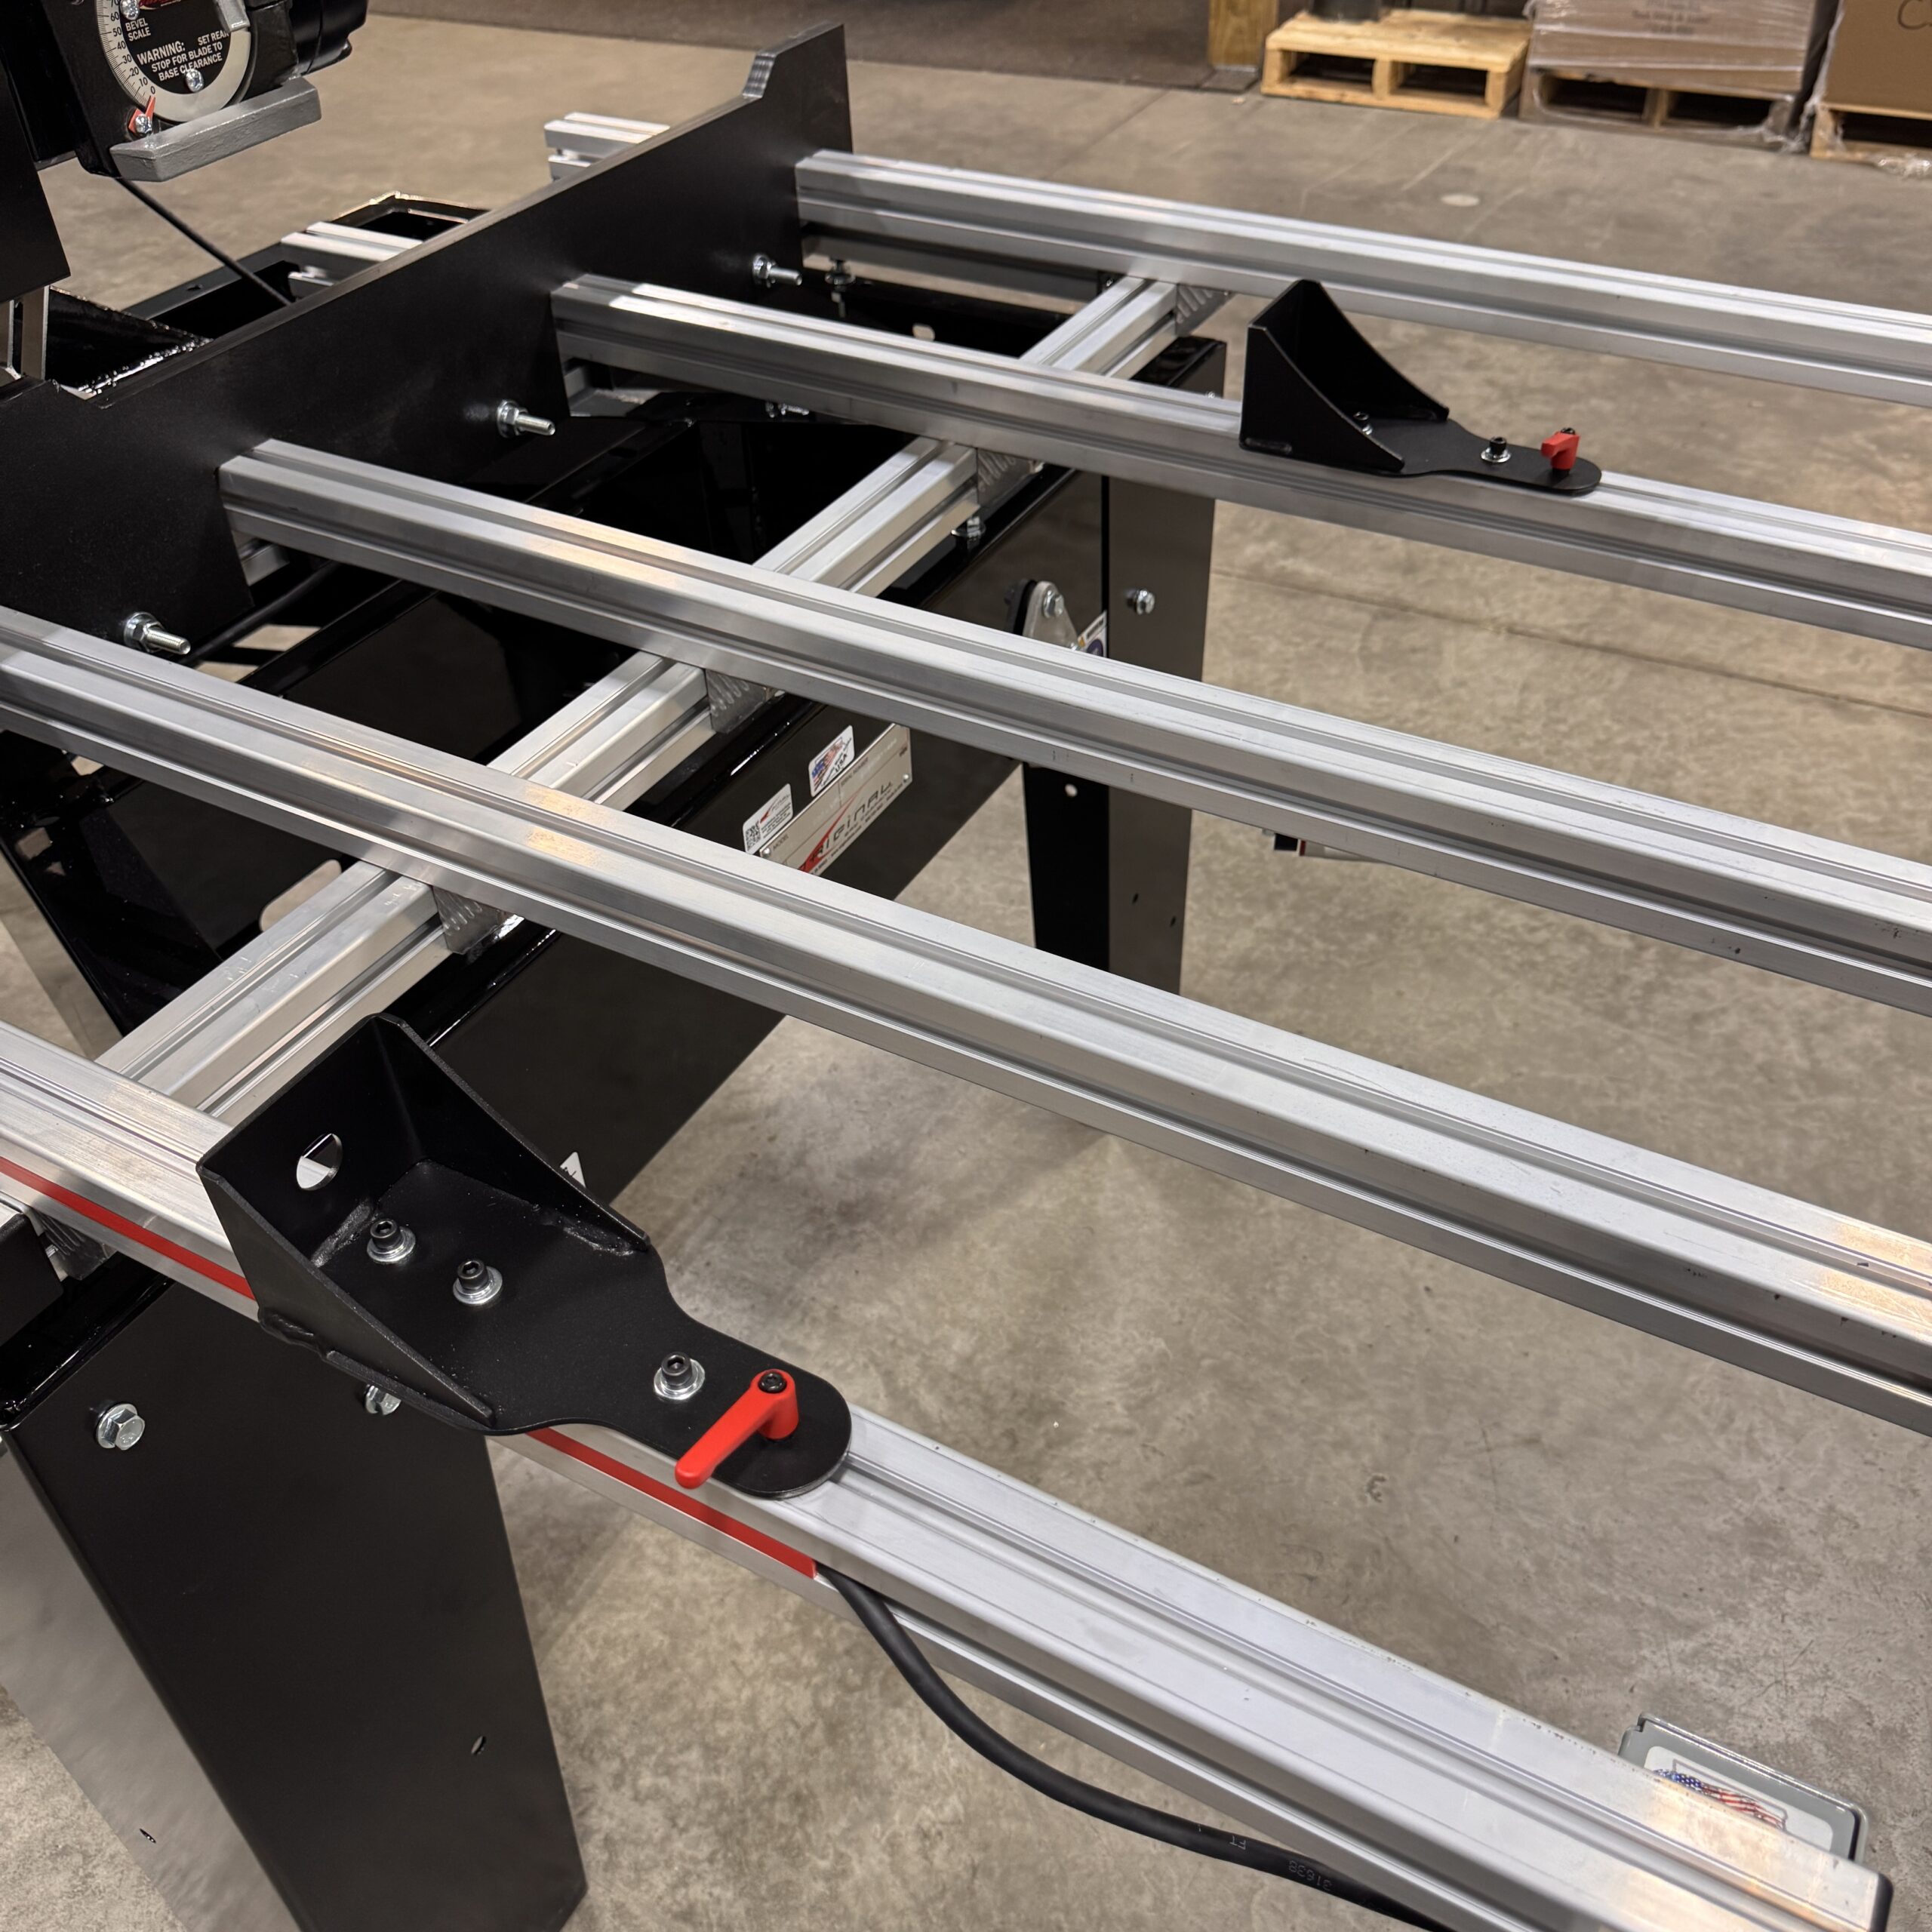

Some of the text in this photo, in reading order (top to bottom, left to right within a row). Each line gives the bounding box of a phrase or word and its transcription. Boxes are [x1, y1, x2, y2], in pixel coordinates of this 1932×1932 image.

[110, 11, 120, 22] 60
[125, 17, 149, 32] BEVEL
[112, 26, 122, 37] 50
[128, 27, 151, 42] SCALE
[117, 41, 126, 50] 40
[137, 41, 186, 66] WARNING:
[198, 34, 211, 46] SET
[122, 54, 132, 64] 30
[152, 42, 223, 72] STOP FOR BLADE TO
[129, 66, 139, 76] 20
[158, 53, 223, 82] BASE CLEARANCE
[139, 77, 148, 87] 10
[150, 85, 156, 94] 0
[1229, 1835, 1247, 1850] FT
